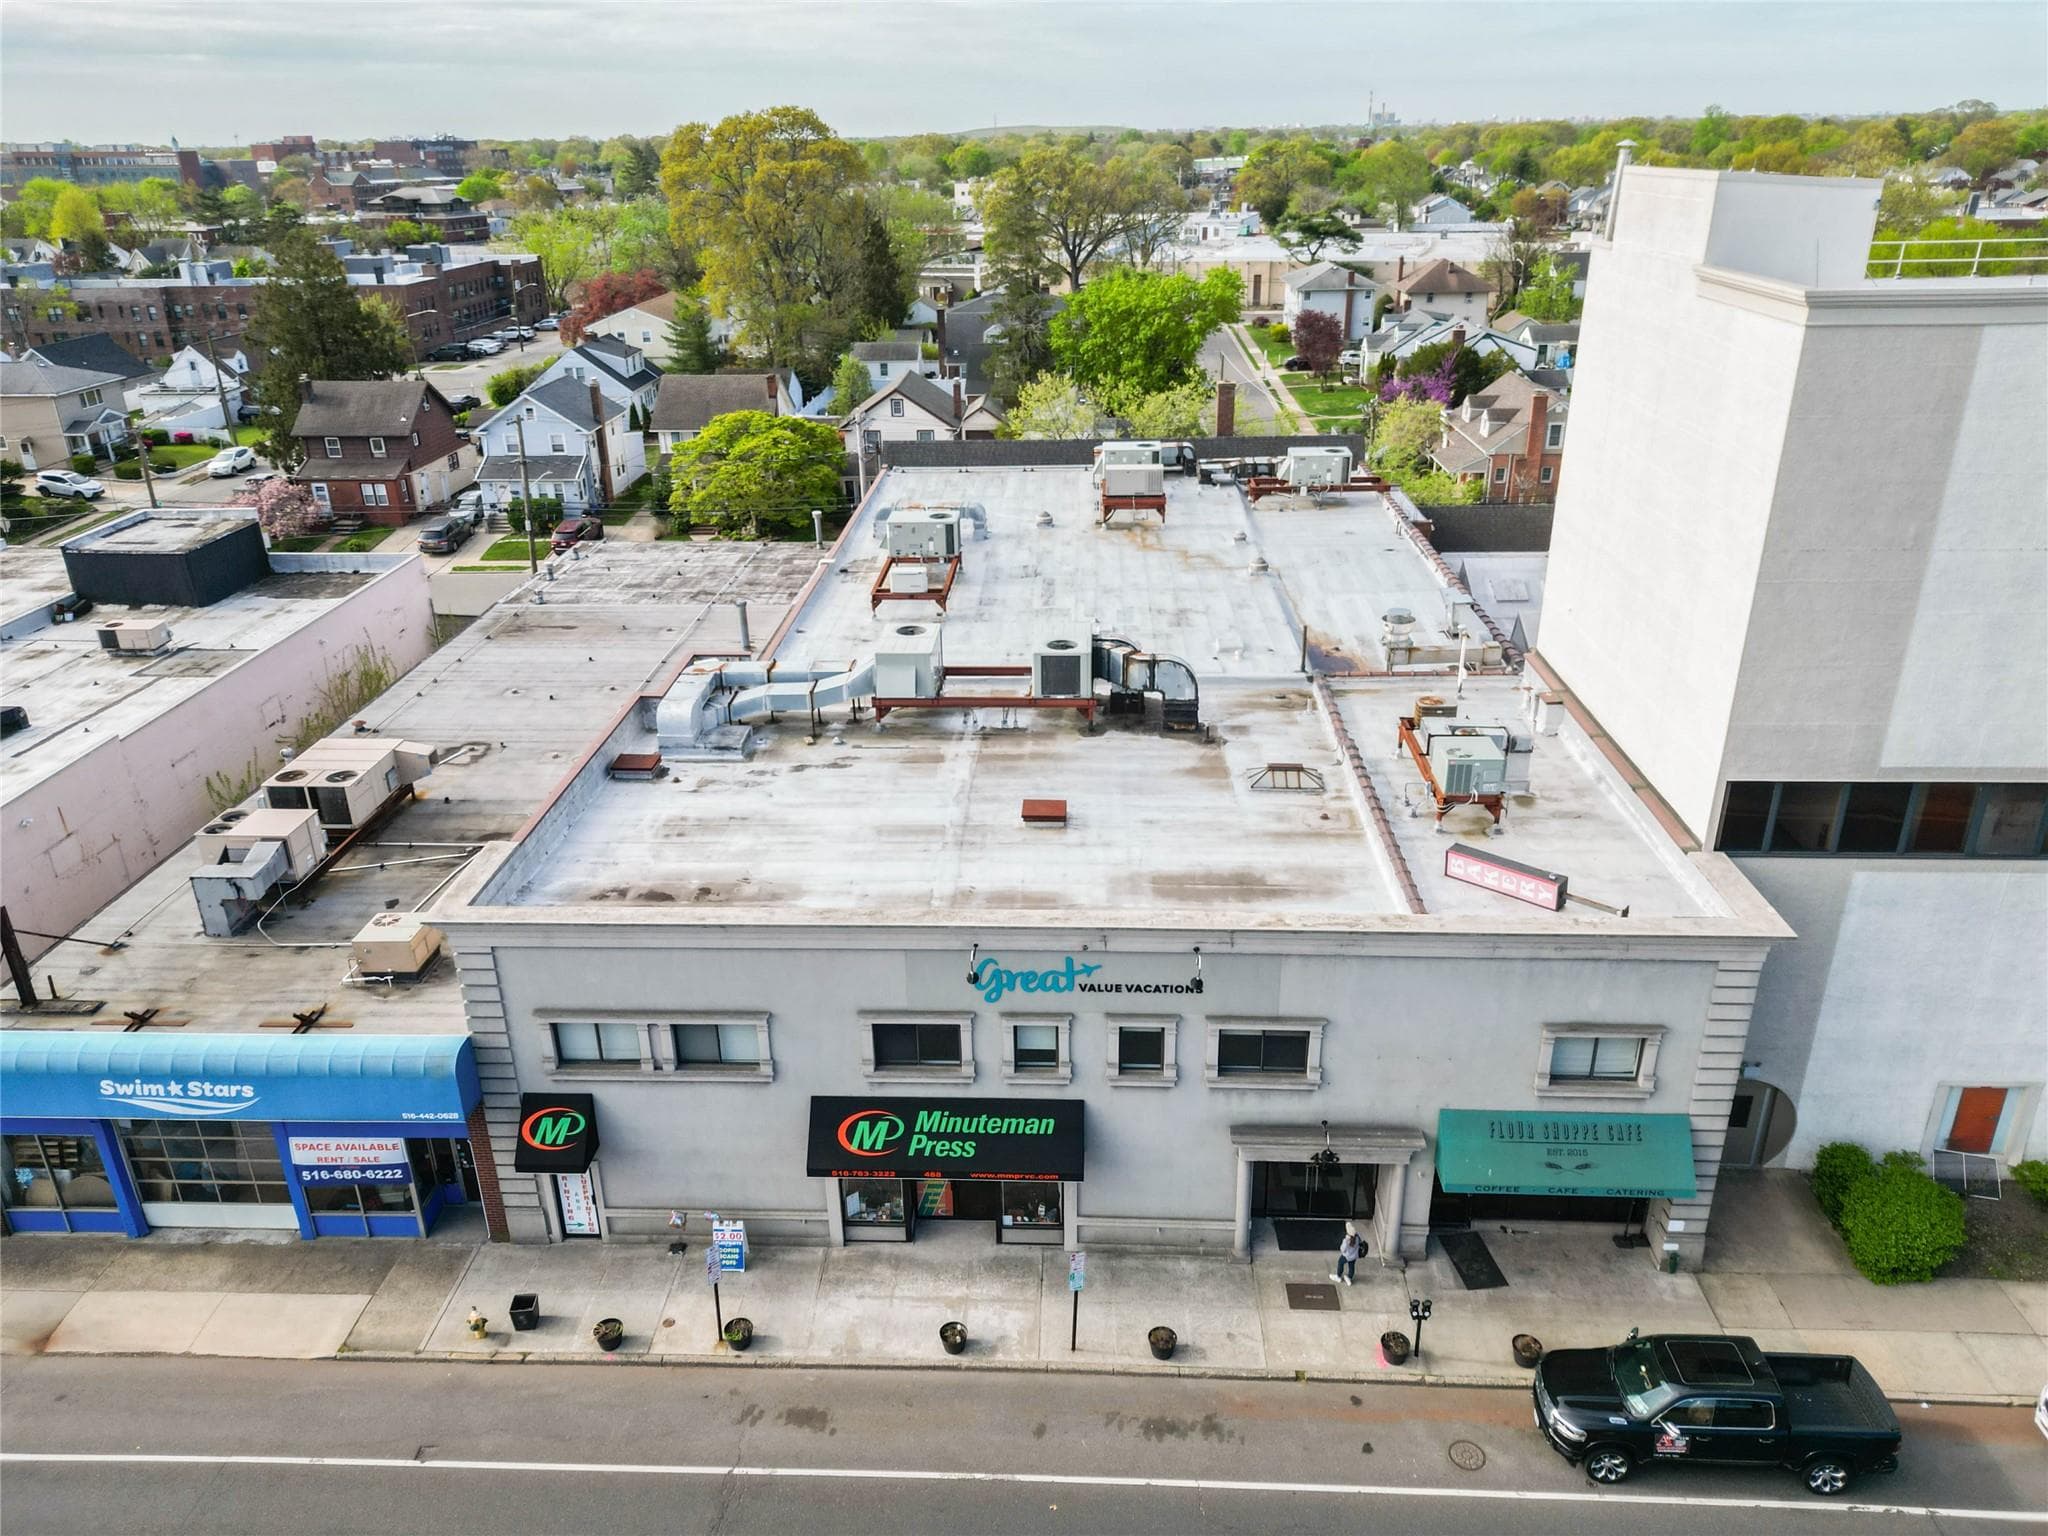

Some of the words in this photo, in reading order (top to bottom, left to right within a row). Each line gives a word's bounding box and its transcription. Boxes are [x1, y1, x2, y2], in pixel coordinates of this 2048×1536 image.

[1451, 857, 1554, 900] BAKERY
[1079, 983, 1122, 993] VALUE
[100, 1078, 165, 1097] Swim
[187, 1081, 254, 1097] Stars
[914, 1110, 1055, 1135] Minuteman
[1488, 1120, 1535, 1140] FLOUR
[1543, 1121, 1599, 1141] SHOPPE
[1608, 1122, 1643, 1142] CAFE
[295, 1142, 331, 1151] SPACE
[335, 1142, 400, 1151] AVAILABLE
[908, 1134, 977, 1158] Press
[302, 1169, 403, 1180] 516-680-6222
[1475, 1184, 1521, 1193] COFFEE
[1548, 1187, 1579, 1195] CAFE
[1606, 1188, 1665, 1197] CATERING
